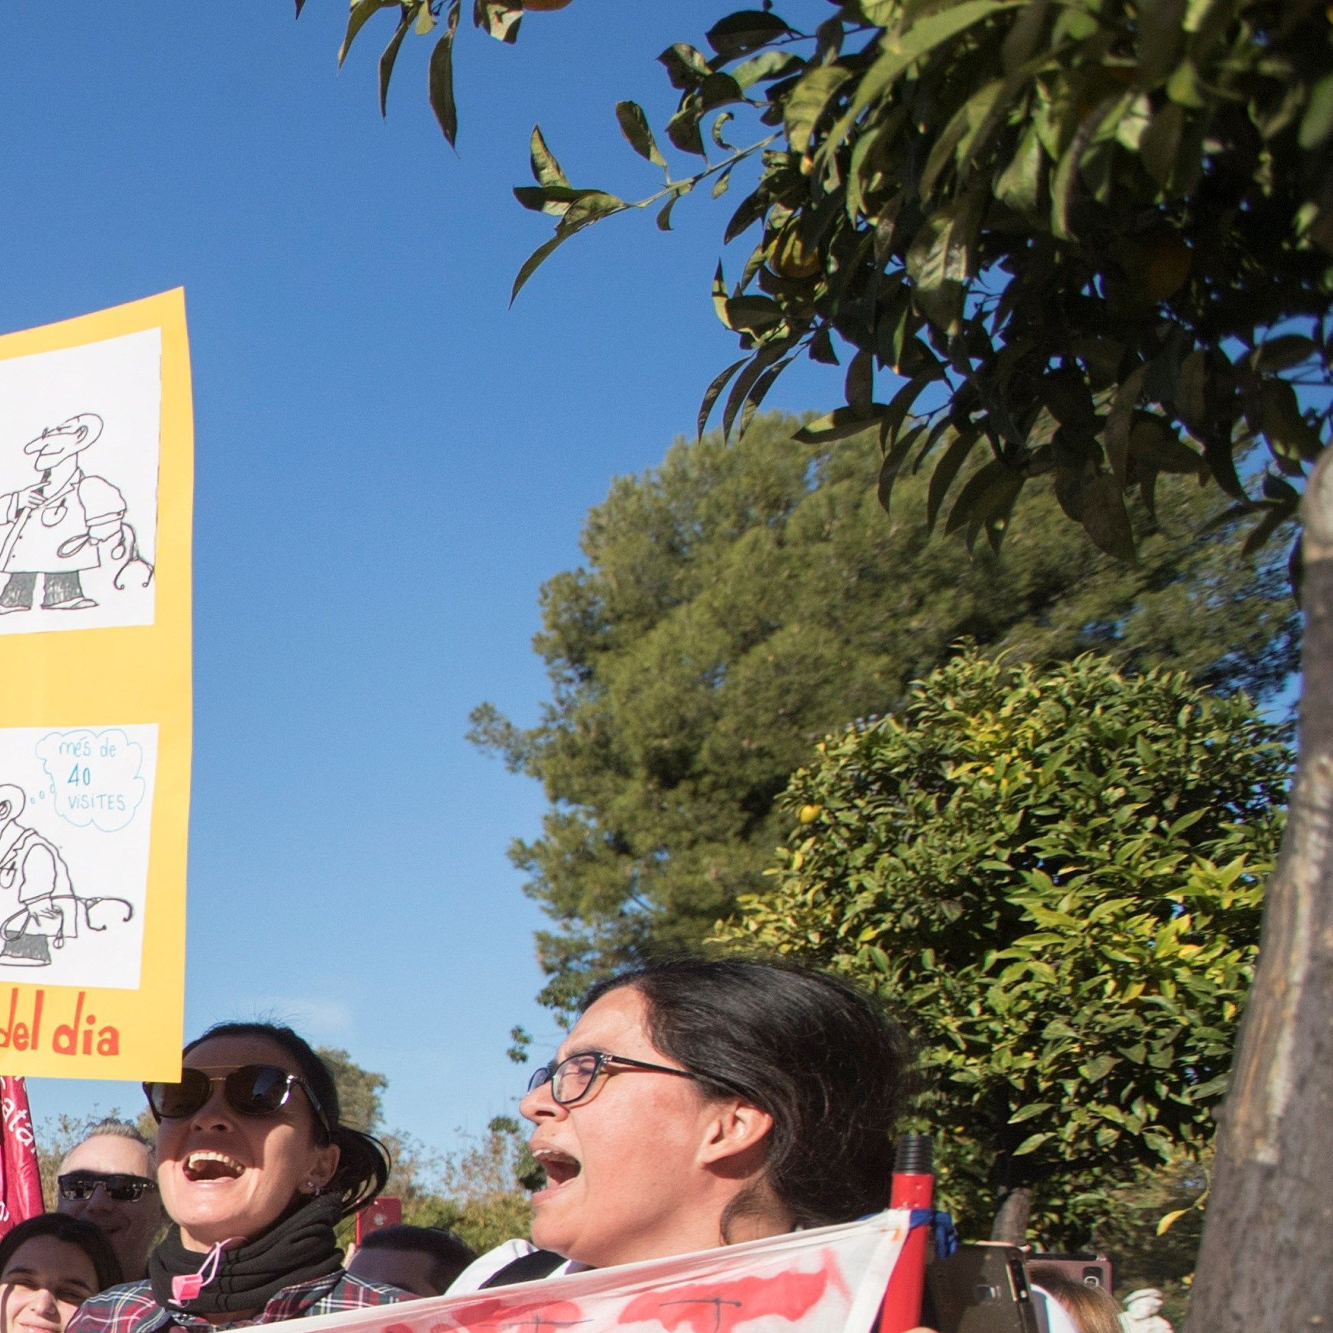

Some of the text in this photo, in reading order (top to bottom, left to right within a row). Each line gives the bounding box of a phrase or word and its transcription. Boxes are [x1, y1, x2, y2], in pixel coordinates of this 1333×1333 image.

[100, 737, 116, 757] de
[68, 763, 91, 786] 40
[52, 992, 121, 1059] dia
